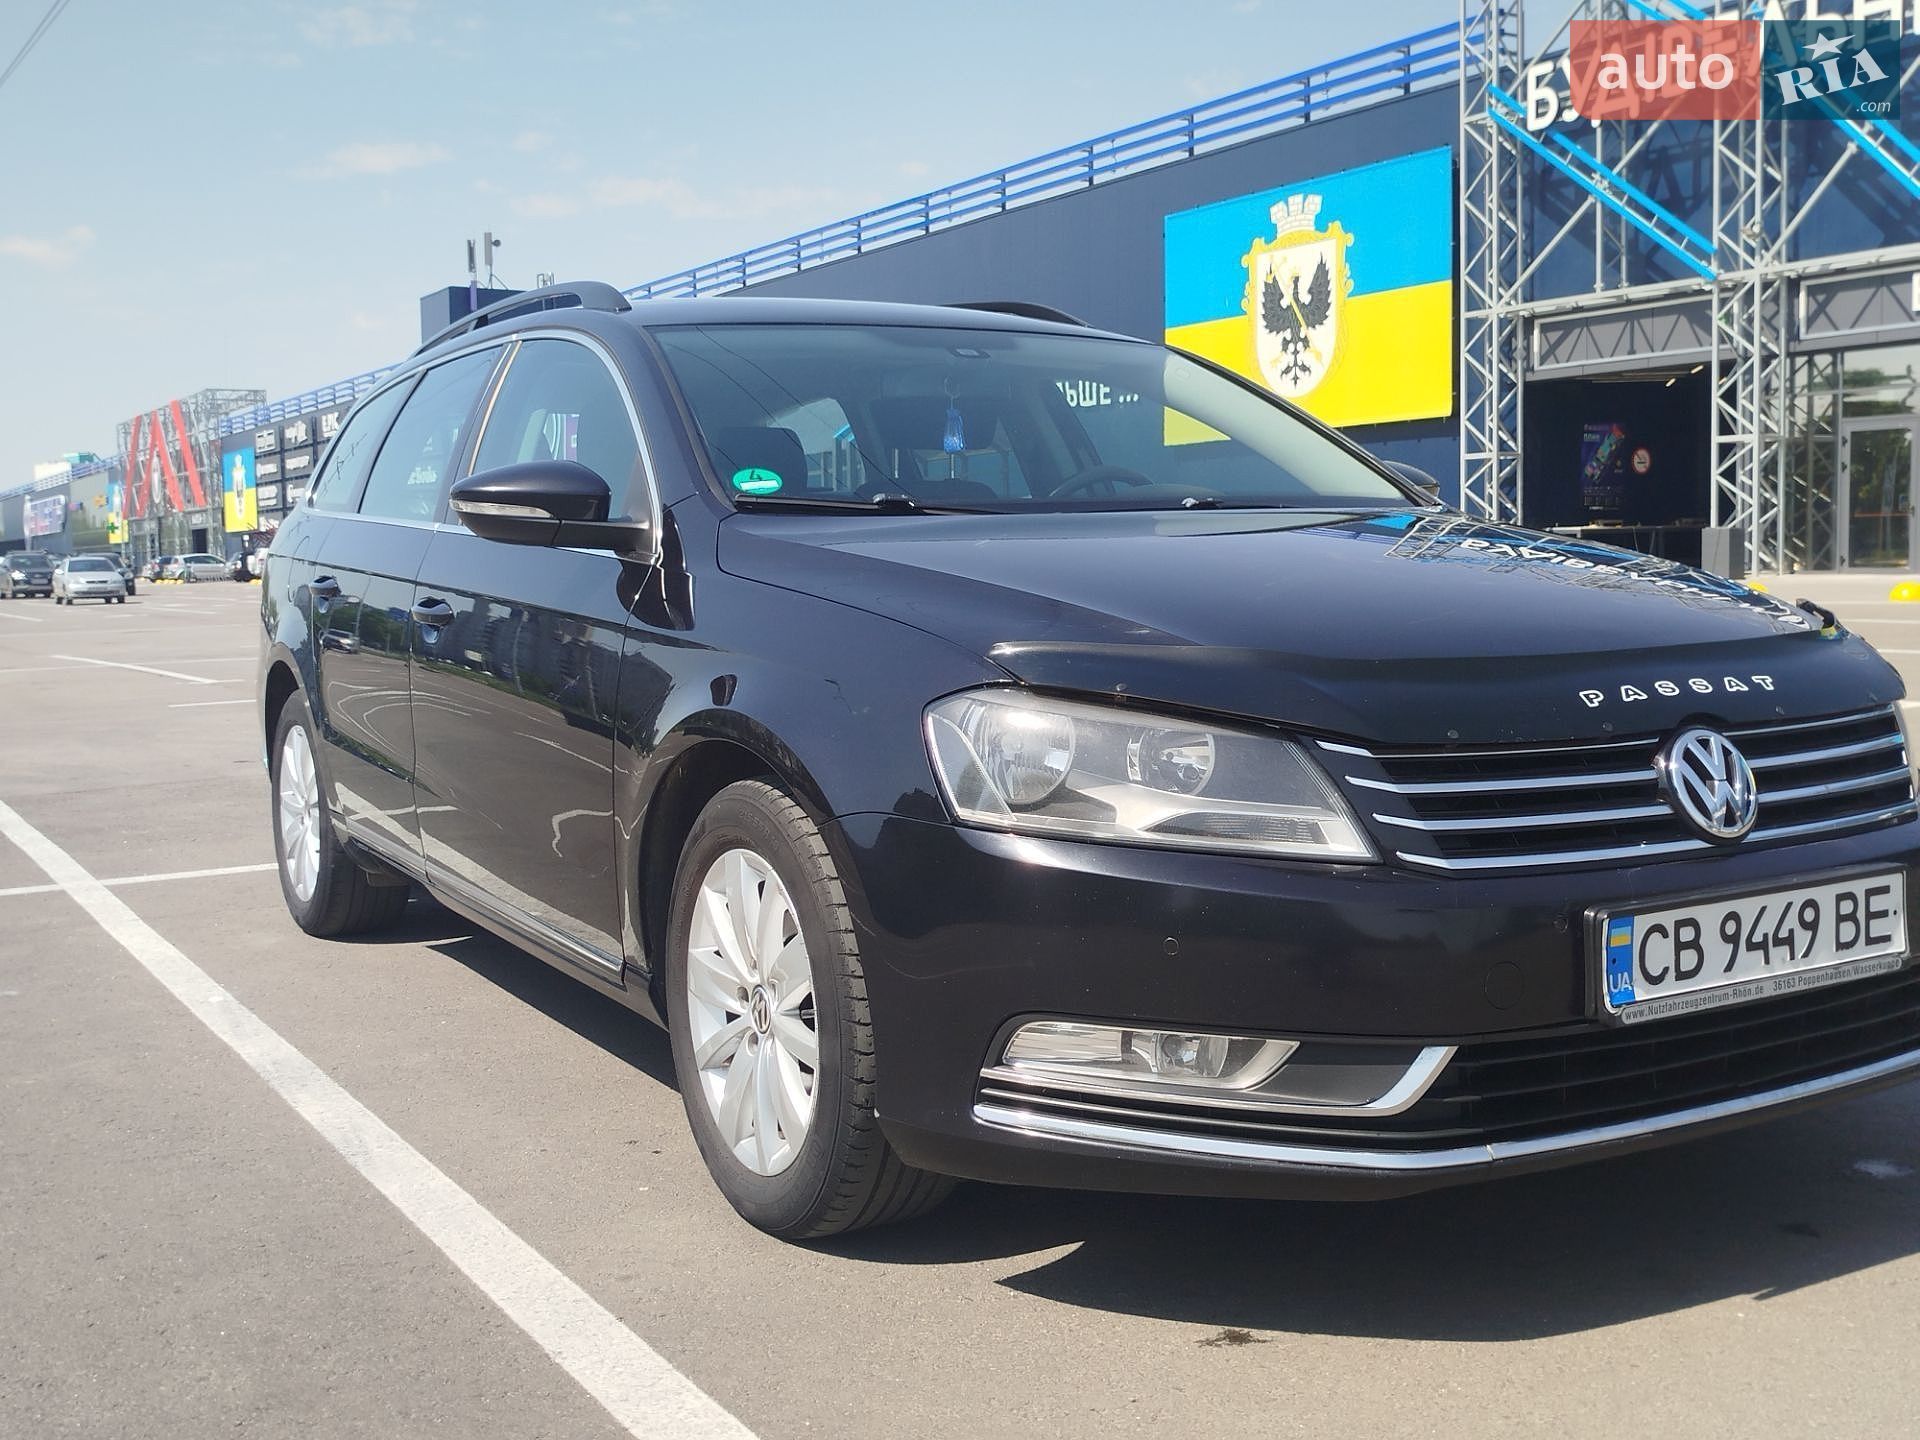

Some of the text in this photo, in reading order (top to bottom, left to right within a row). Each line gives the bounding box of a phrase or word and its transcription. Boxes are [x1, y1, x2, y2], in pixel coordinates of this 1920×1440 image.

[1056, 380, 1112, 408] ЬШЕ
[1579, 675, 1775, 708] PASSAT
[1638, 884, 1893, 987] CB 9449 BE
[1609, 971, 1634, 993] UA
[1773, 977, 1796, 992] 36163
